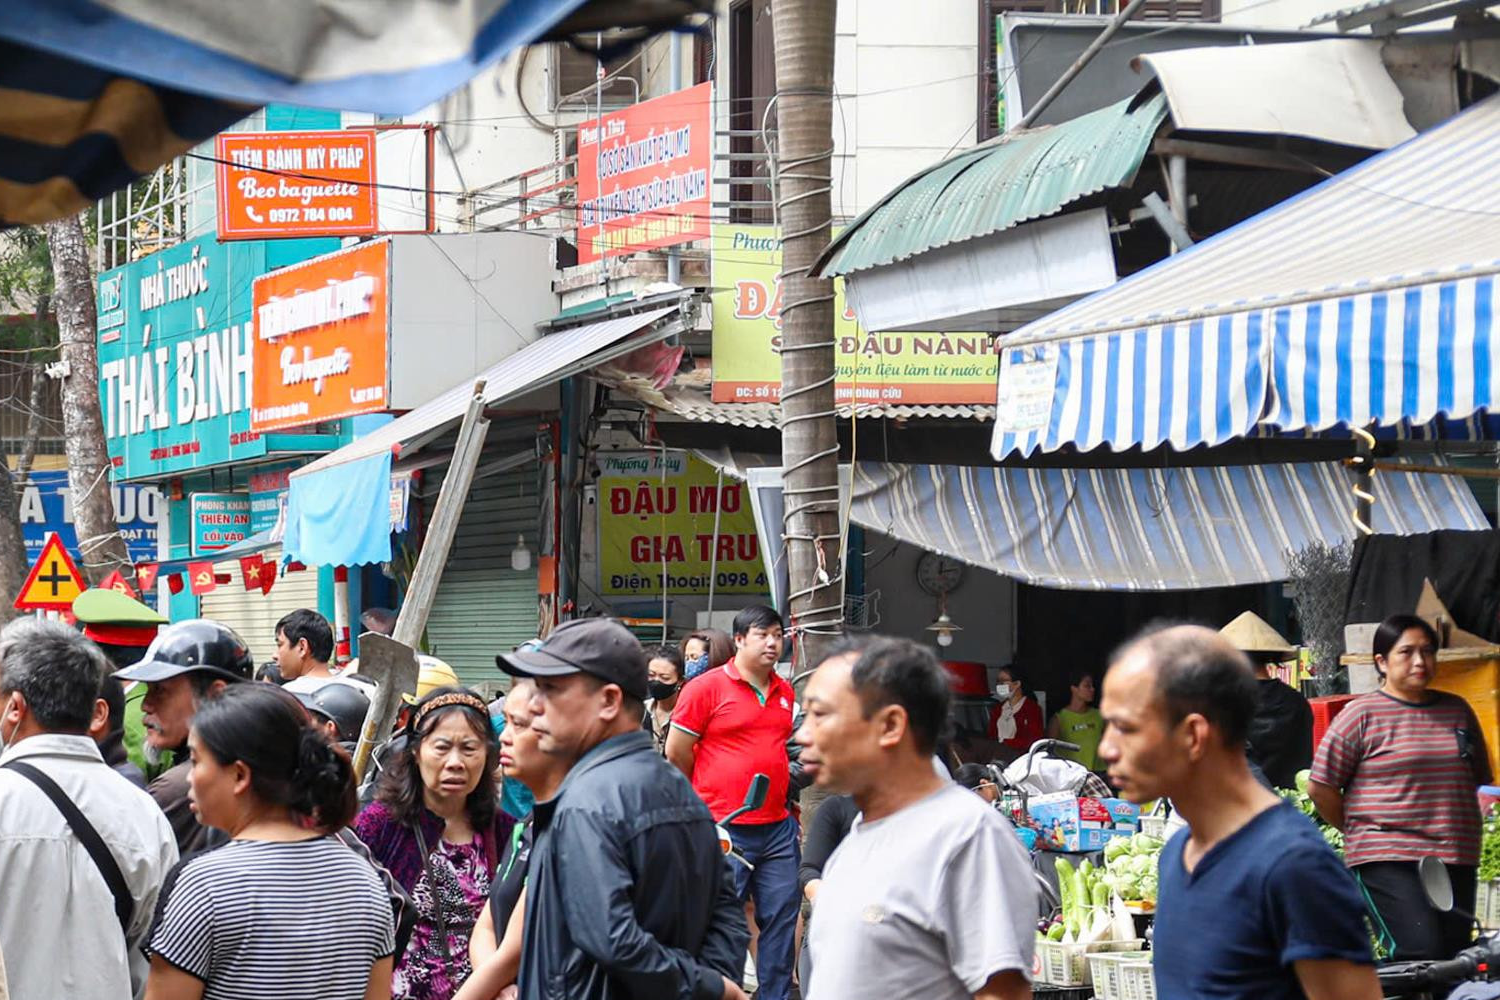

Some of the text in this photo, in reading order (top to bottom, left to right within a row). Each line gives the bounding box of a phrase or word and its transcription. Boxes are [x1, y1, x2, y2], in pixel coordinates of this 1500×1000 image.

[231, 146, 263, 175] TIỆM
[266, 145, 302, 171] BÁNH
[329, 143, 364, 169] PHÁP
[237, 177, 360, 206] Beo baguette
[269, 207, 299, 223] 0972
[303, 207, 326, 222] 784
[141, 245, 209, 311] NHÀ THUỐC
[102, 323, 170, 439] THÁI
[177, 306, 253, 426] BÌNH
[875, 363, 900, 378] liệu
[904, 364, 928, 377] làm
[950, 364, 983, 377] nước
[610, 480, 742, 521] ĐẬU MƠ
[233, 514, 249, 524] AN
[630, 534, 759, 563] GIA TRU
[611, 573, 651, 593] Điện
[657, 573, 711, 592] Thoại:
[717, 574, 749, 587] 098
